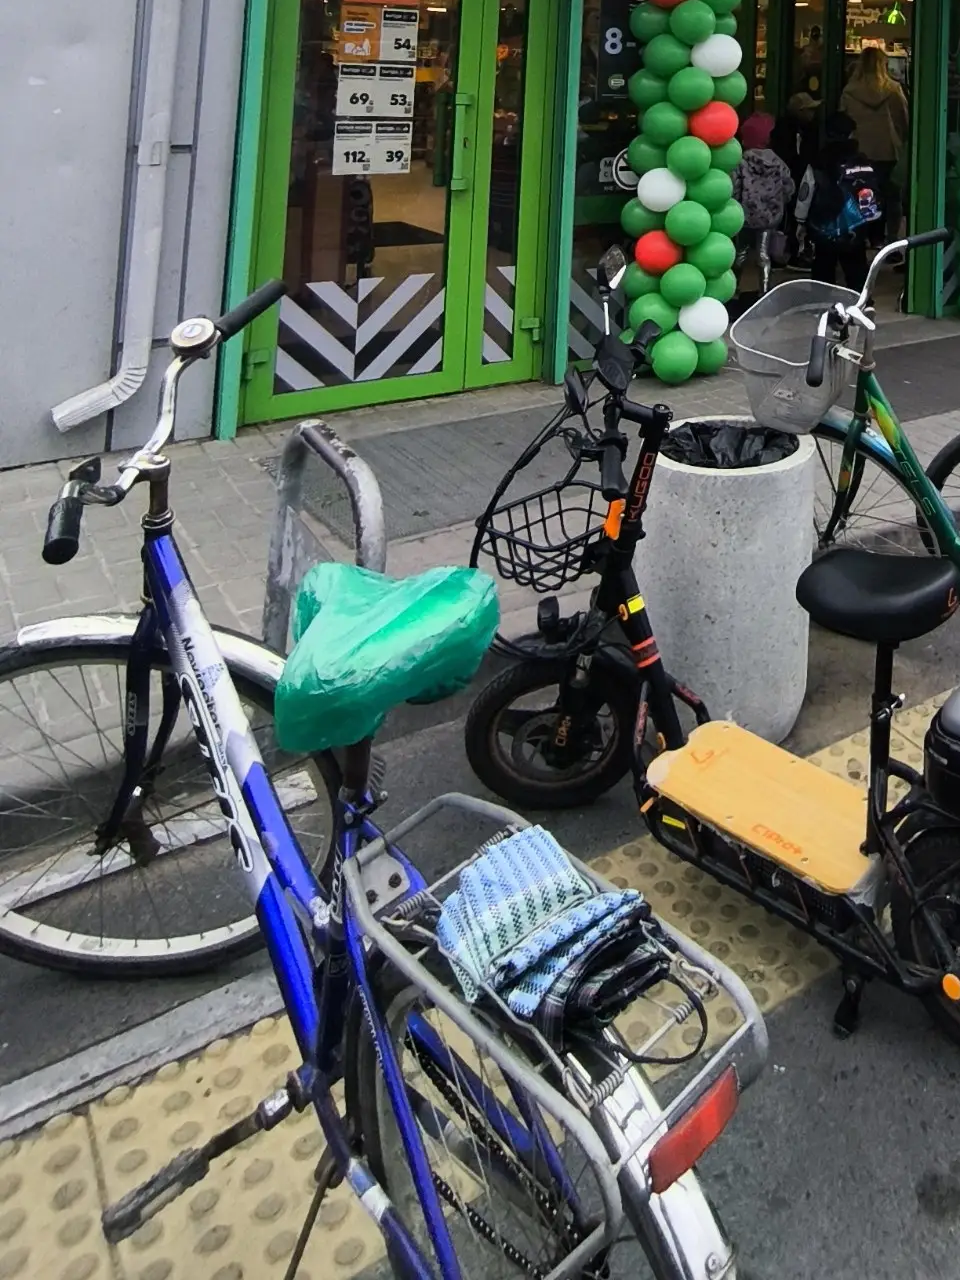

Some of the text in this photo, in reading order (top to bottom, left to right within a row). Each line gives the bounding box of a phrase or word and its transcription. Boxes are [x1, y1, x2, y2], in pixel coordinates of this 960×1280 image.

[394, 38, 412, 50] 54
[349, 92, 370, 105] 69
[390, 94, 408, 106] 53
[343, 150, 366, 163] 112
[385, 150, 405, 163] 39
[628, 452, 656, 522] KUGOO
[895, 447, 937, 517] TELS
